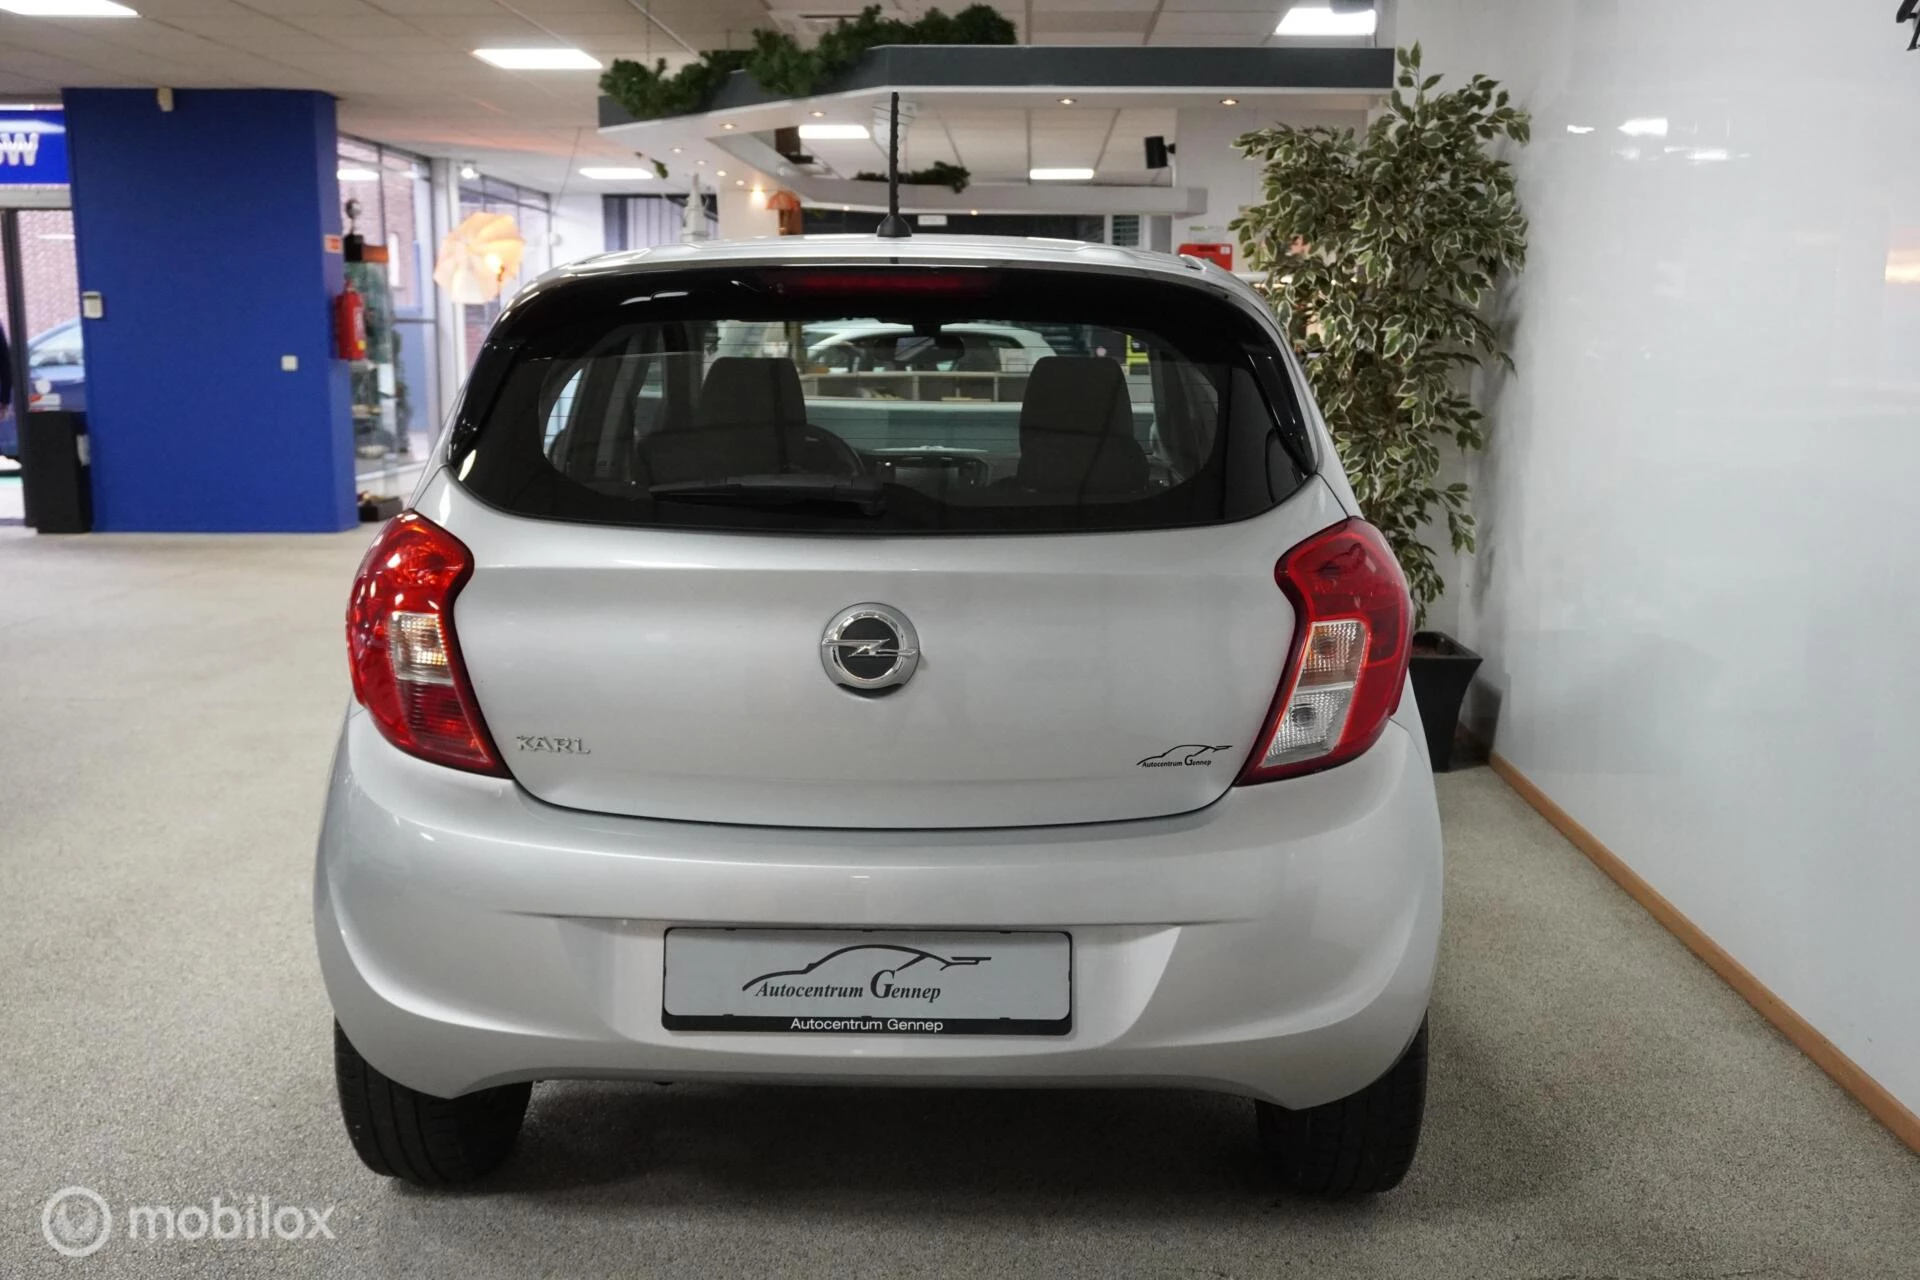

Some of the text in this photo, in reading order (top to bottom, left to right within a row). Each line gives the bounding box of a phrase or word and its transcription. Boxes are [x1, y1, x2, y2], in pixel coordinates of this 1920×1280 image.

[516, 736, 592, 755] KARL
[1142, 754, 1212, 768] Autocentrum Gennep
[755, 969, 941, 1003] Autocentrum Gennep
[790, 1017, 944, 1033] Autocentrum Gennep
